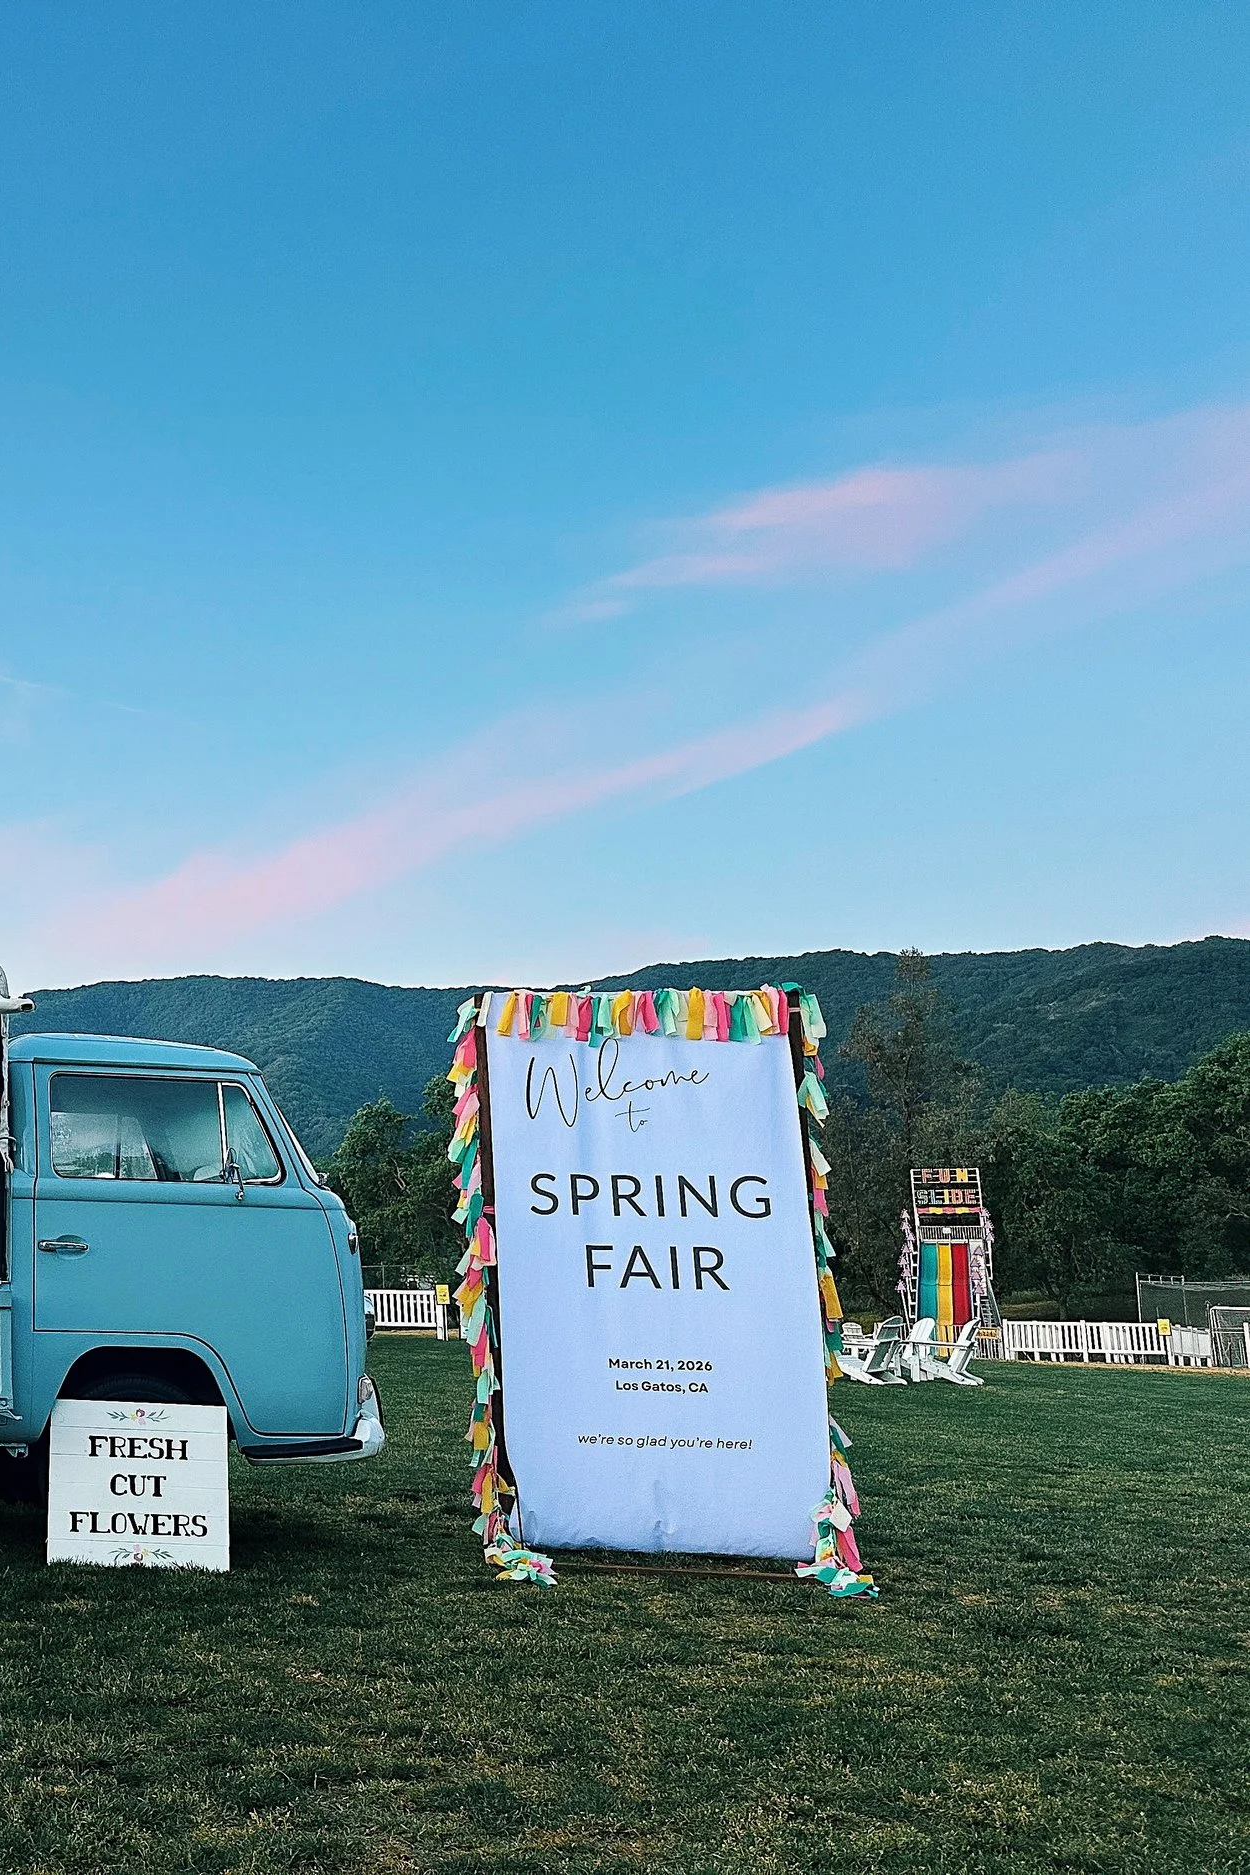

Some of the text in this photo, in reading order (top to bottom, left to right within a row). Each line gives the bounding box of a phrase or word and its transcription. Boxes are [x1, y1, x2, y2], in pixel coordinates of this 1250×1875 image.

[525, 1038, 710, 1128] Welcome
[614, 1101, 651, 1133] to
[921, 1168, 969, 1184] FUN
[530, 1173, 772, 1219] SPRING
[916, 1189, 977, 1205] SLIDE
[585, 1245, 730, 1291] FAIR
[608, 1358, 713, 1373] March 21, 2026
[615, 1380, 709, 1395] Los Gatos, CA
[88, 1435, 188, 1461] FRESH
[578, 1434, 753, 1450] we're so glad you're here!
[110, 1473, 167, 1498] CUT
[69, 1511, 208, 1538] FLOWERS
